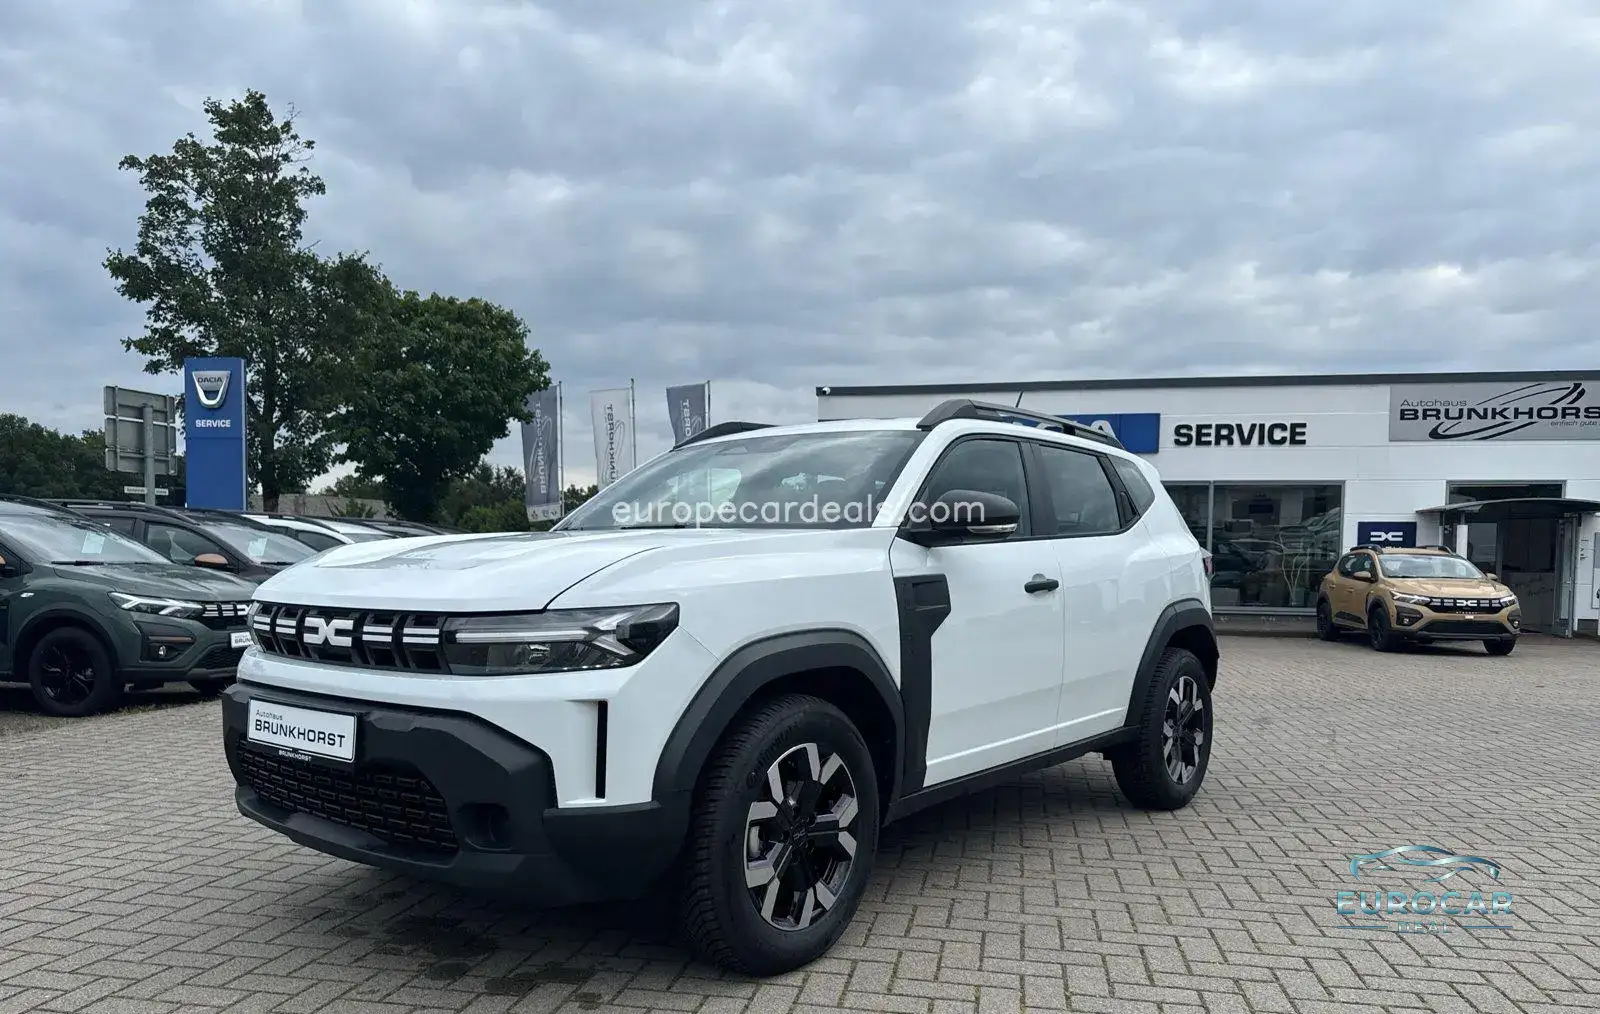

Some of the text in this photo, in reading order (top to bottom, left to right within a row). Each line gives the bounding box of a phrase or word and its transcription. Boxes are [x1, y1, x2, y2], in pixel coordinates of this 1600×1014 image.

[197, 376, 223, 384] DACIA
[1400, 398, 1468, 407] Autohaus
[195, 419, 231, 428] SERVICE
[1174, 423, 1307, 446] SERVICE
[255, 709, 283, 720] Autohaus
[255, 719, 346, 748] BRUNKHORST
[278, 750, 312, 761] BRUNKHORST
